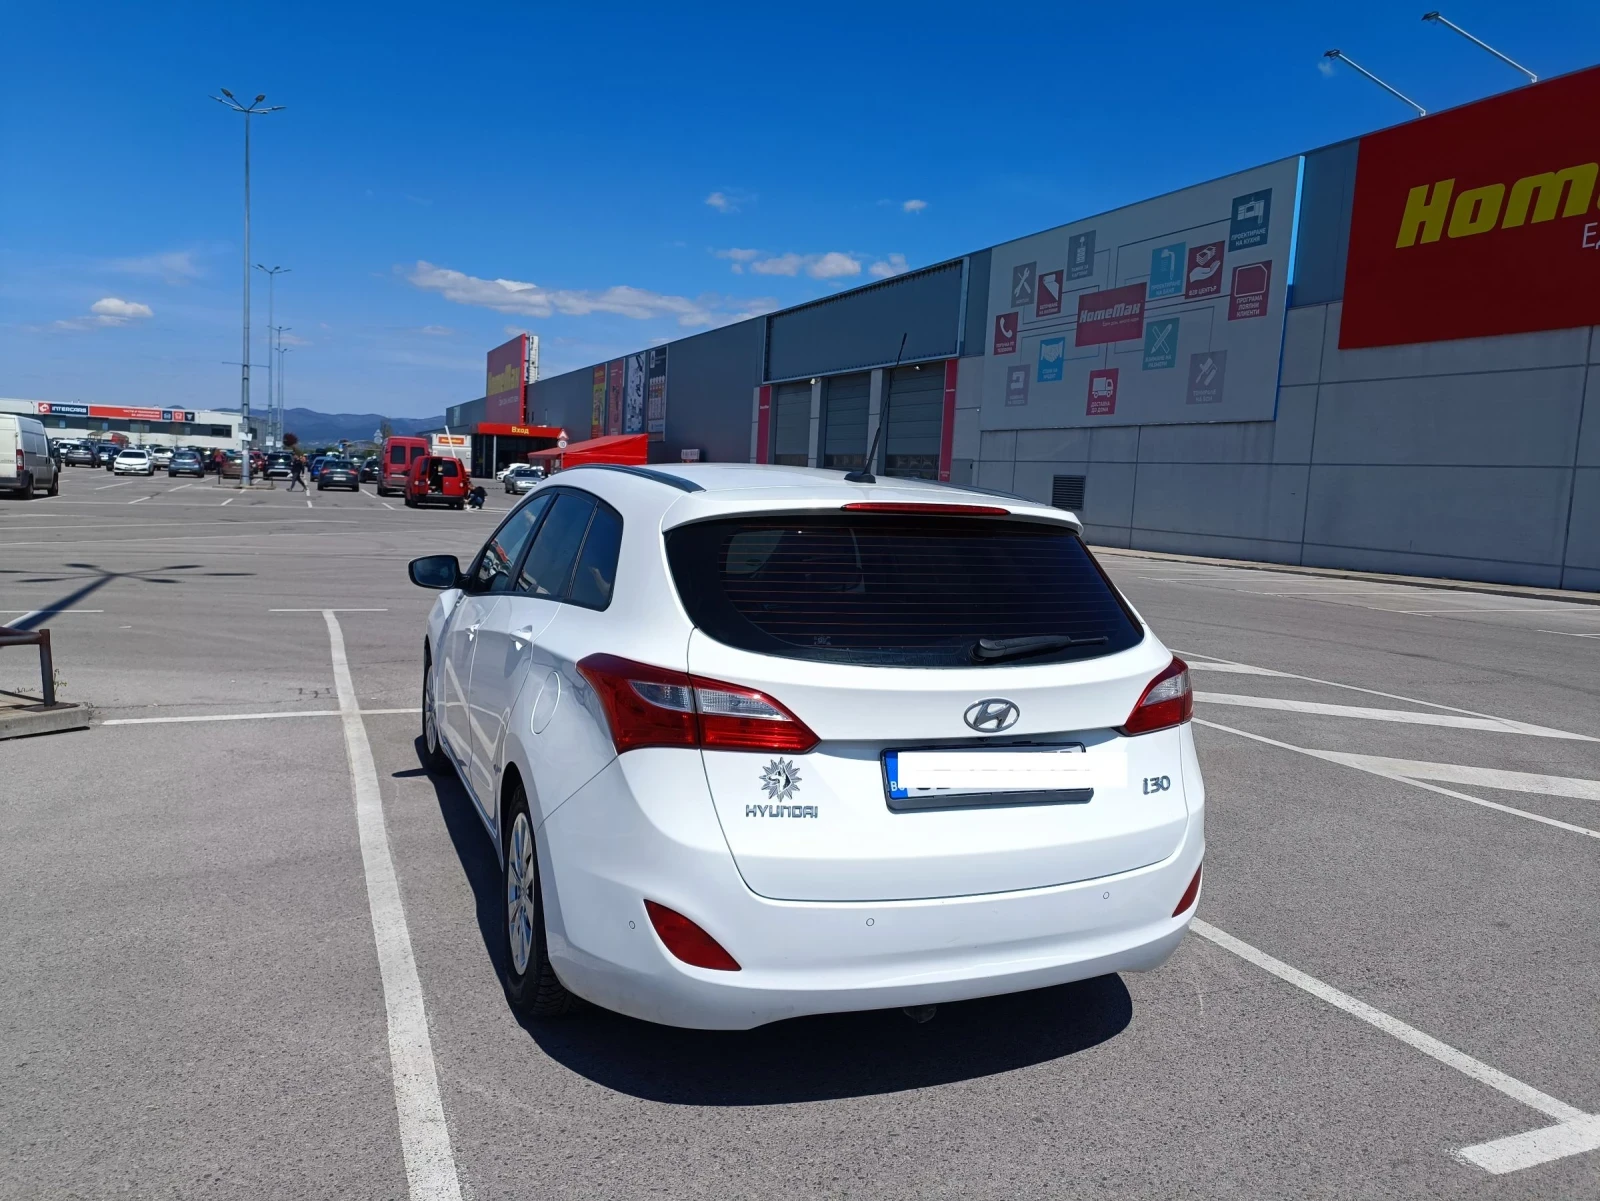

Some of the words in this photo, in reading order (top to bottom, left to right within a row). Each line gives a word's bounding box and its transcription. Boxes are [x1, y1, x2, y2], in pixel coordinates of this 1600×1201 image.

[1395, 162, 1600, 248] Hom
[1231, 228, 1266, 241] ПРОЕКТИРАНЕ
[1243, 236, 1261, 245] КУХНЯ
[1198, 285, 1217, 295] ЦЕНТЪР
[1236, 295, 1263, 304] ПРОГРАМА
[1236, 309, 1260, 317] КЛИЕНТИ
[511, 426, 529, 435] Вход
[745, 804, 818, 818] HYUNDAI
